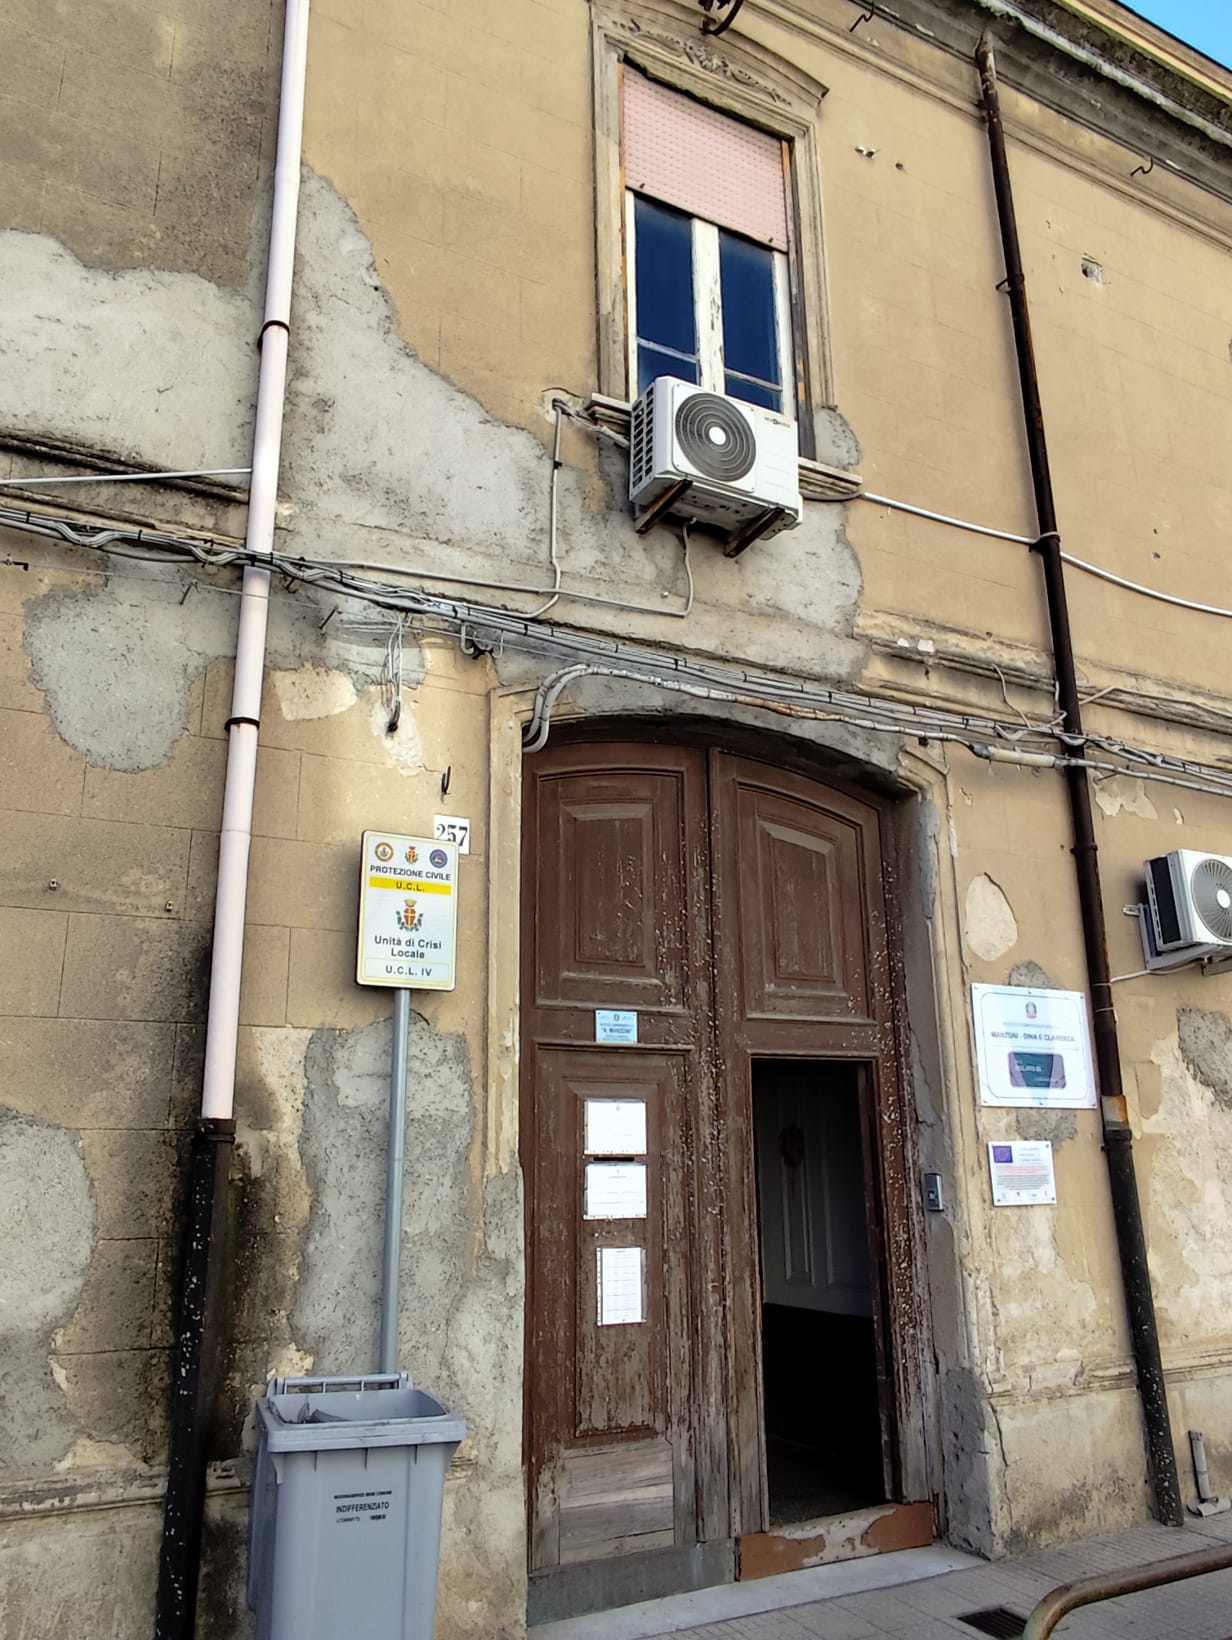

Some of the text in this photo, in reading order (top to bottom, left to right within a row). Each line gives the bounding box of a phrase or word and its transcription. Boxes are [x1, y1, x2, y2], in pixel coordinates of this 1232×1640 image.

[436, 823, 468, 846] 257
[370, 864, 451, 881] PROTEZIONE CIVILE
[396, 881, 425, 892] U.C.L.
[374, 935, 442, 950] Unità di Crisi
[391, 947, 425, 959] Locale
[385, 965, 432, 977] U.C.L. IV
[336, 1501, 390, 1513] INDIFFERENZIATO
